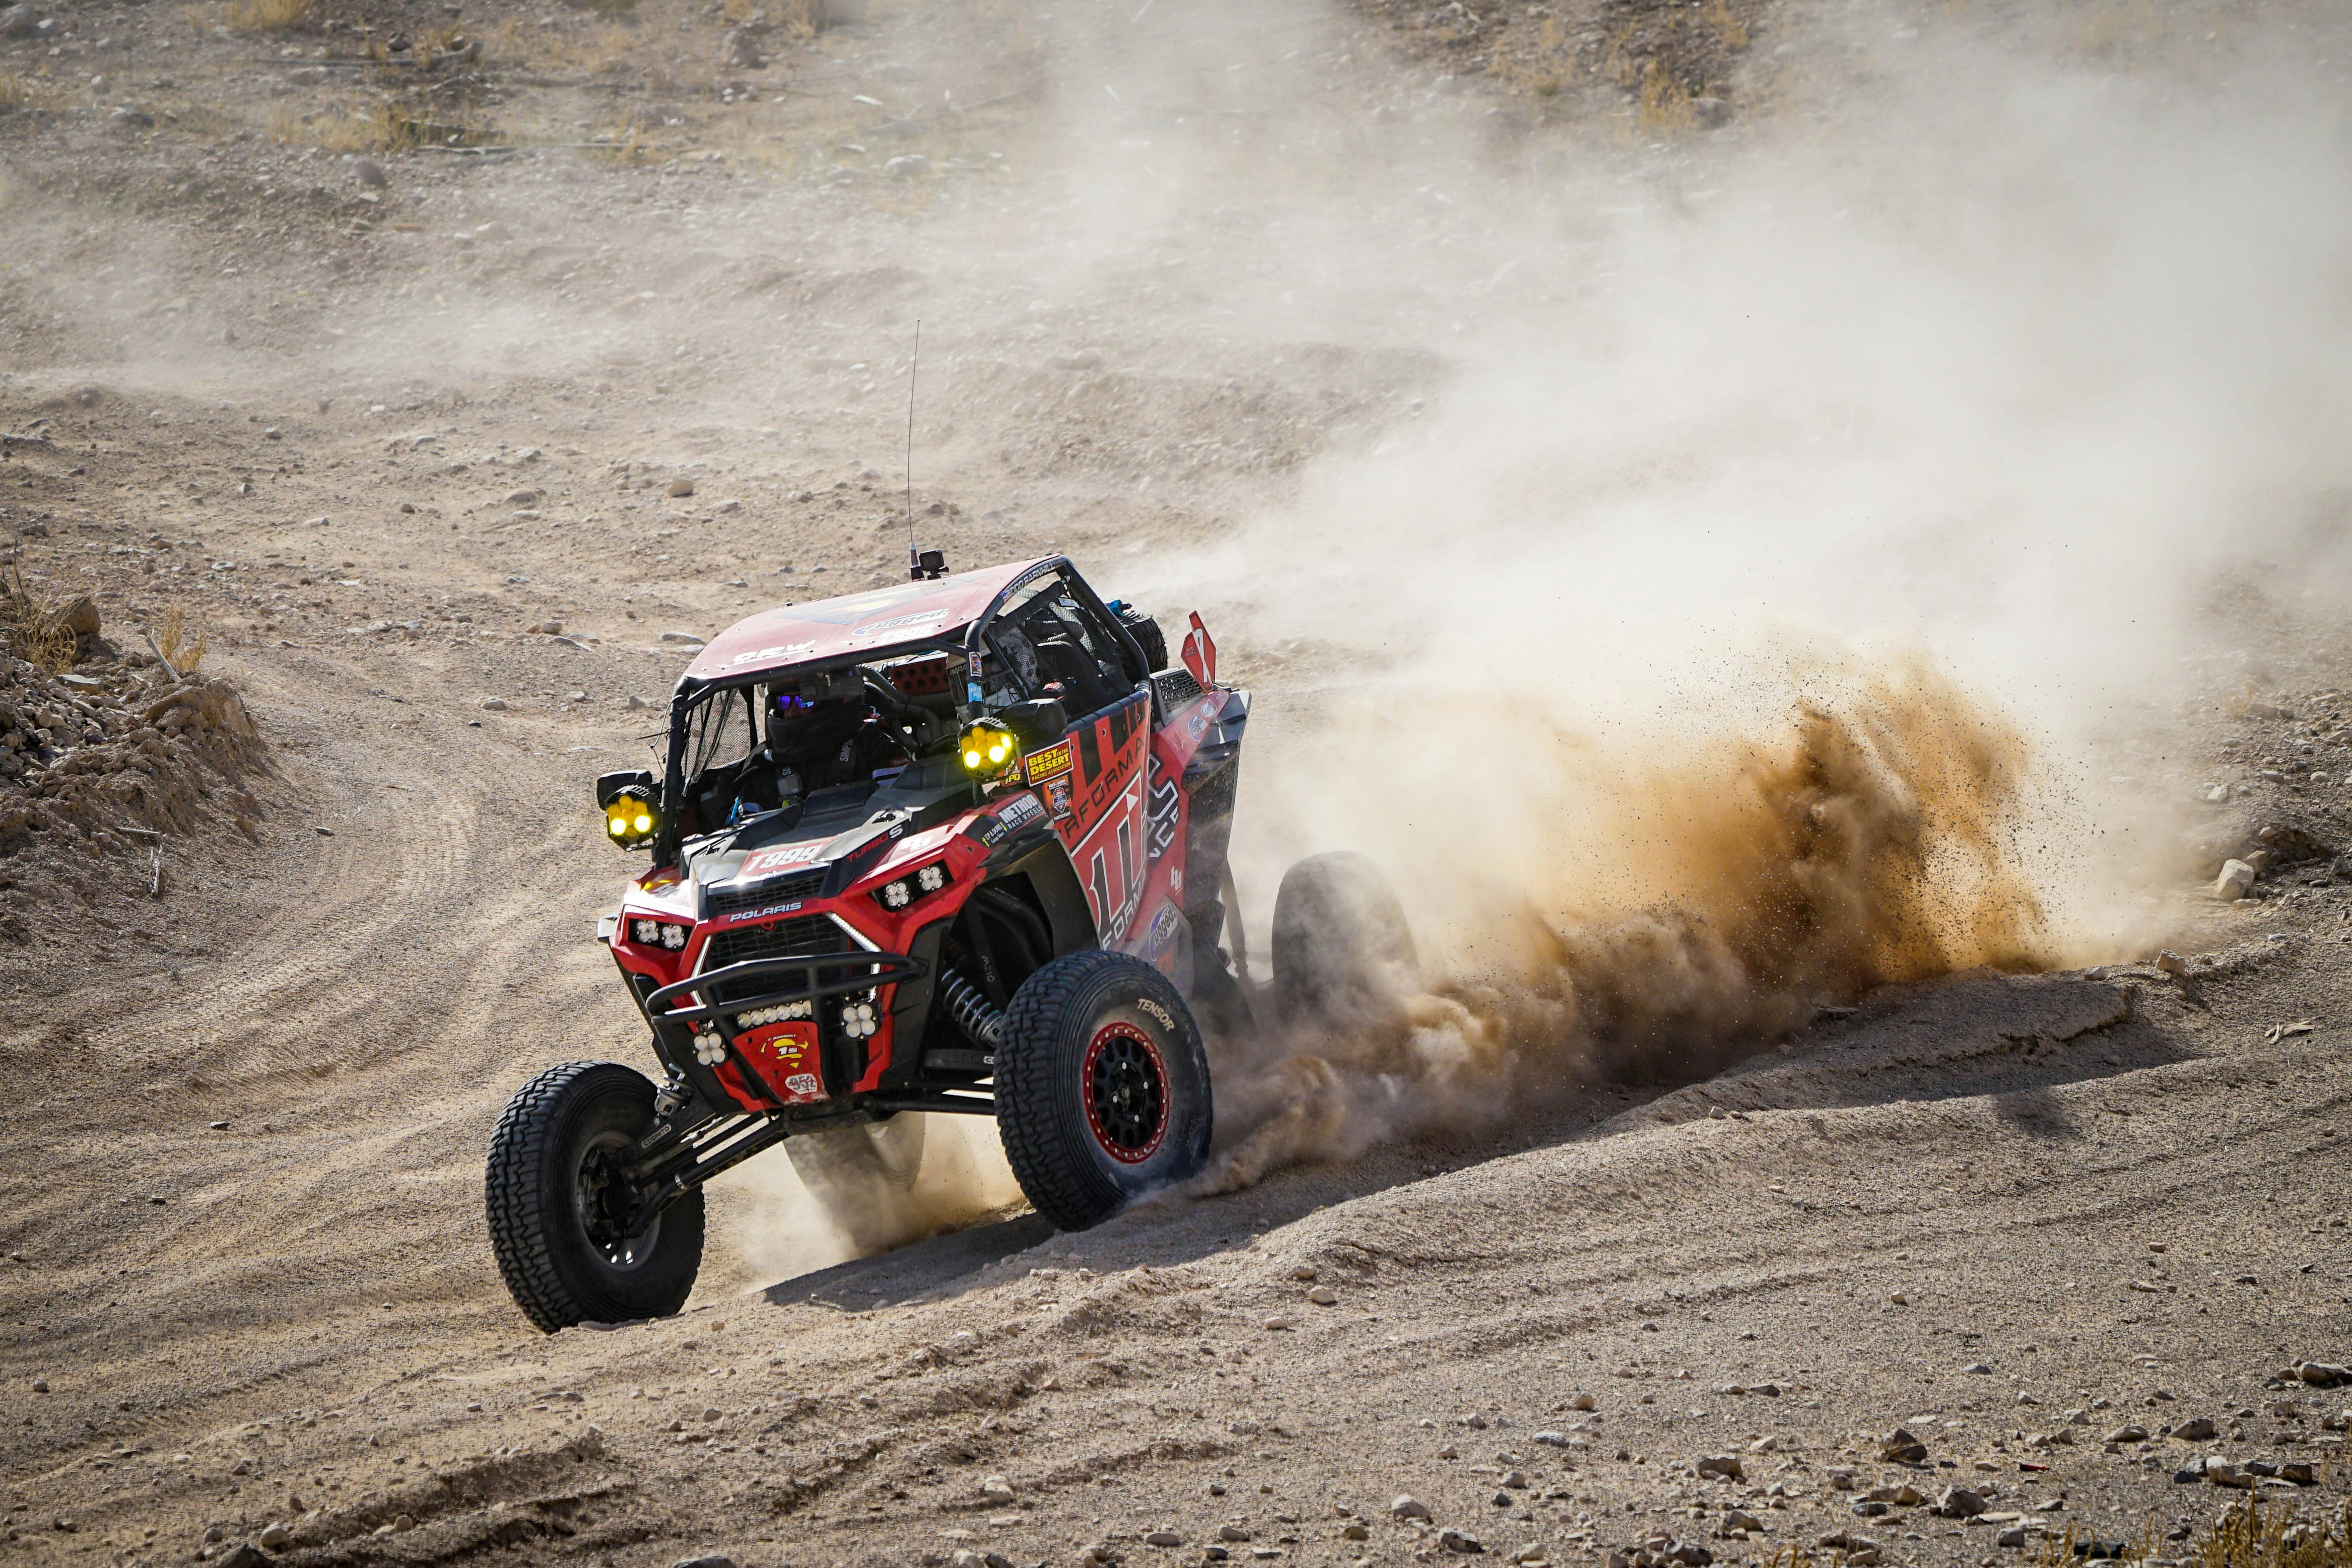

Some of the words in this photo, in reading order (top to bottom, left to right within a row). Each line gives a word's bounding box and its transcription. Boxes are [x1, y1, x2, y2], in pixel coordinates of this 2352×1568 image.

[1029, 749, 1057, 767] BEST
[1030, 753, 1069, 775] DESERT
[1032, 772, 1047, 781] RACING
[998, 794, 1038, 823] METHOD
[1007, 817, 1022, 830] RACE
[1022, 805, 1042, 820] WHEELS
[846, 832, 889, 862] TURBO
[889, 825, 903, 839] S
[746, 845, 823, 872] T999
[729, 902, 802, 922] POLARIS
[1136, 998, 1174, 1032] TENSOR
